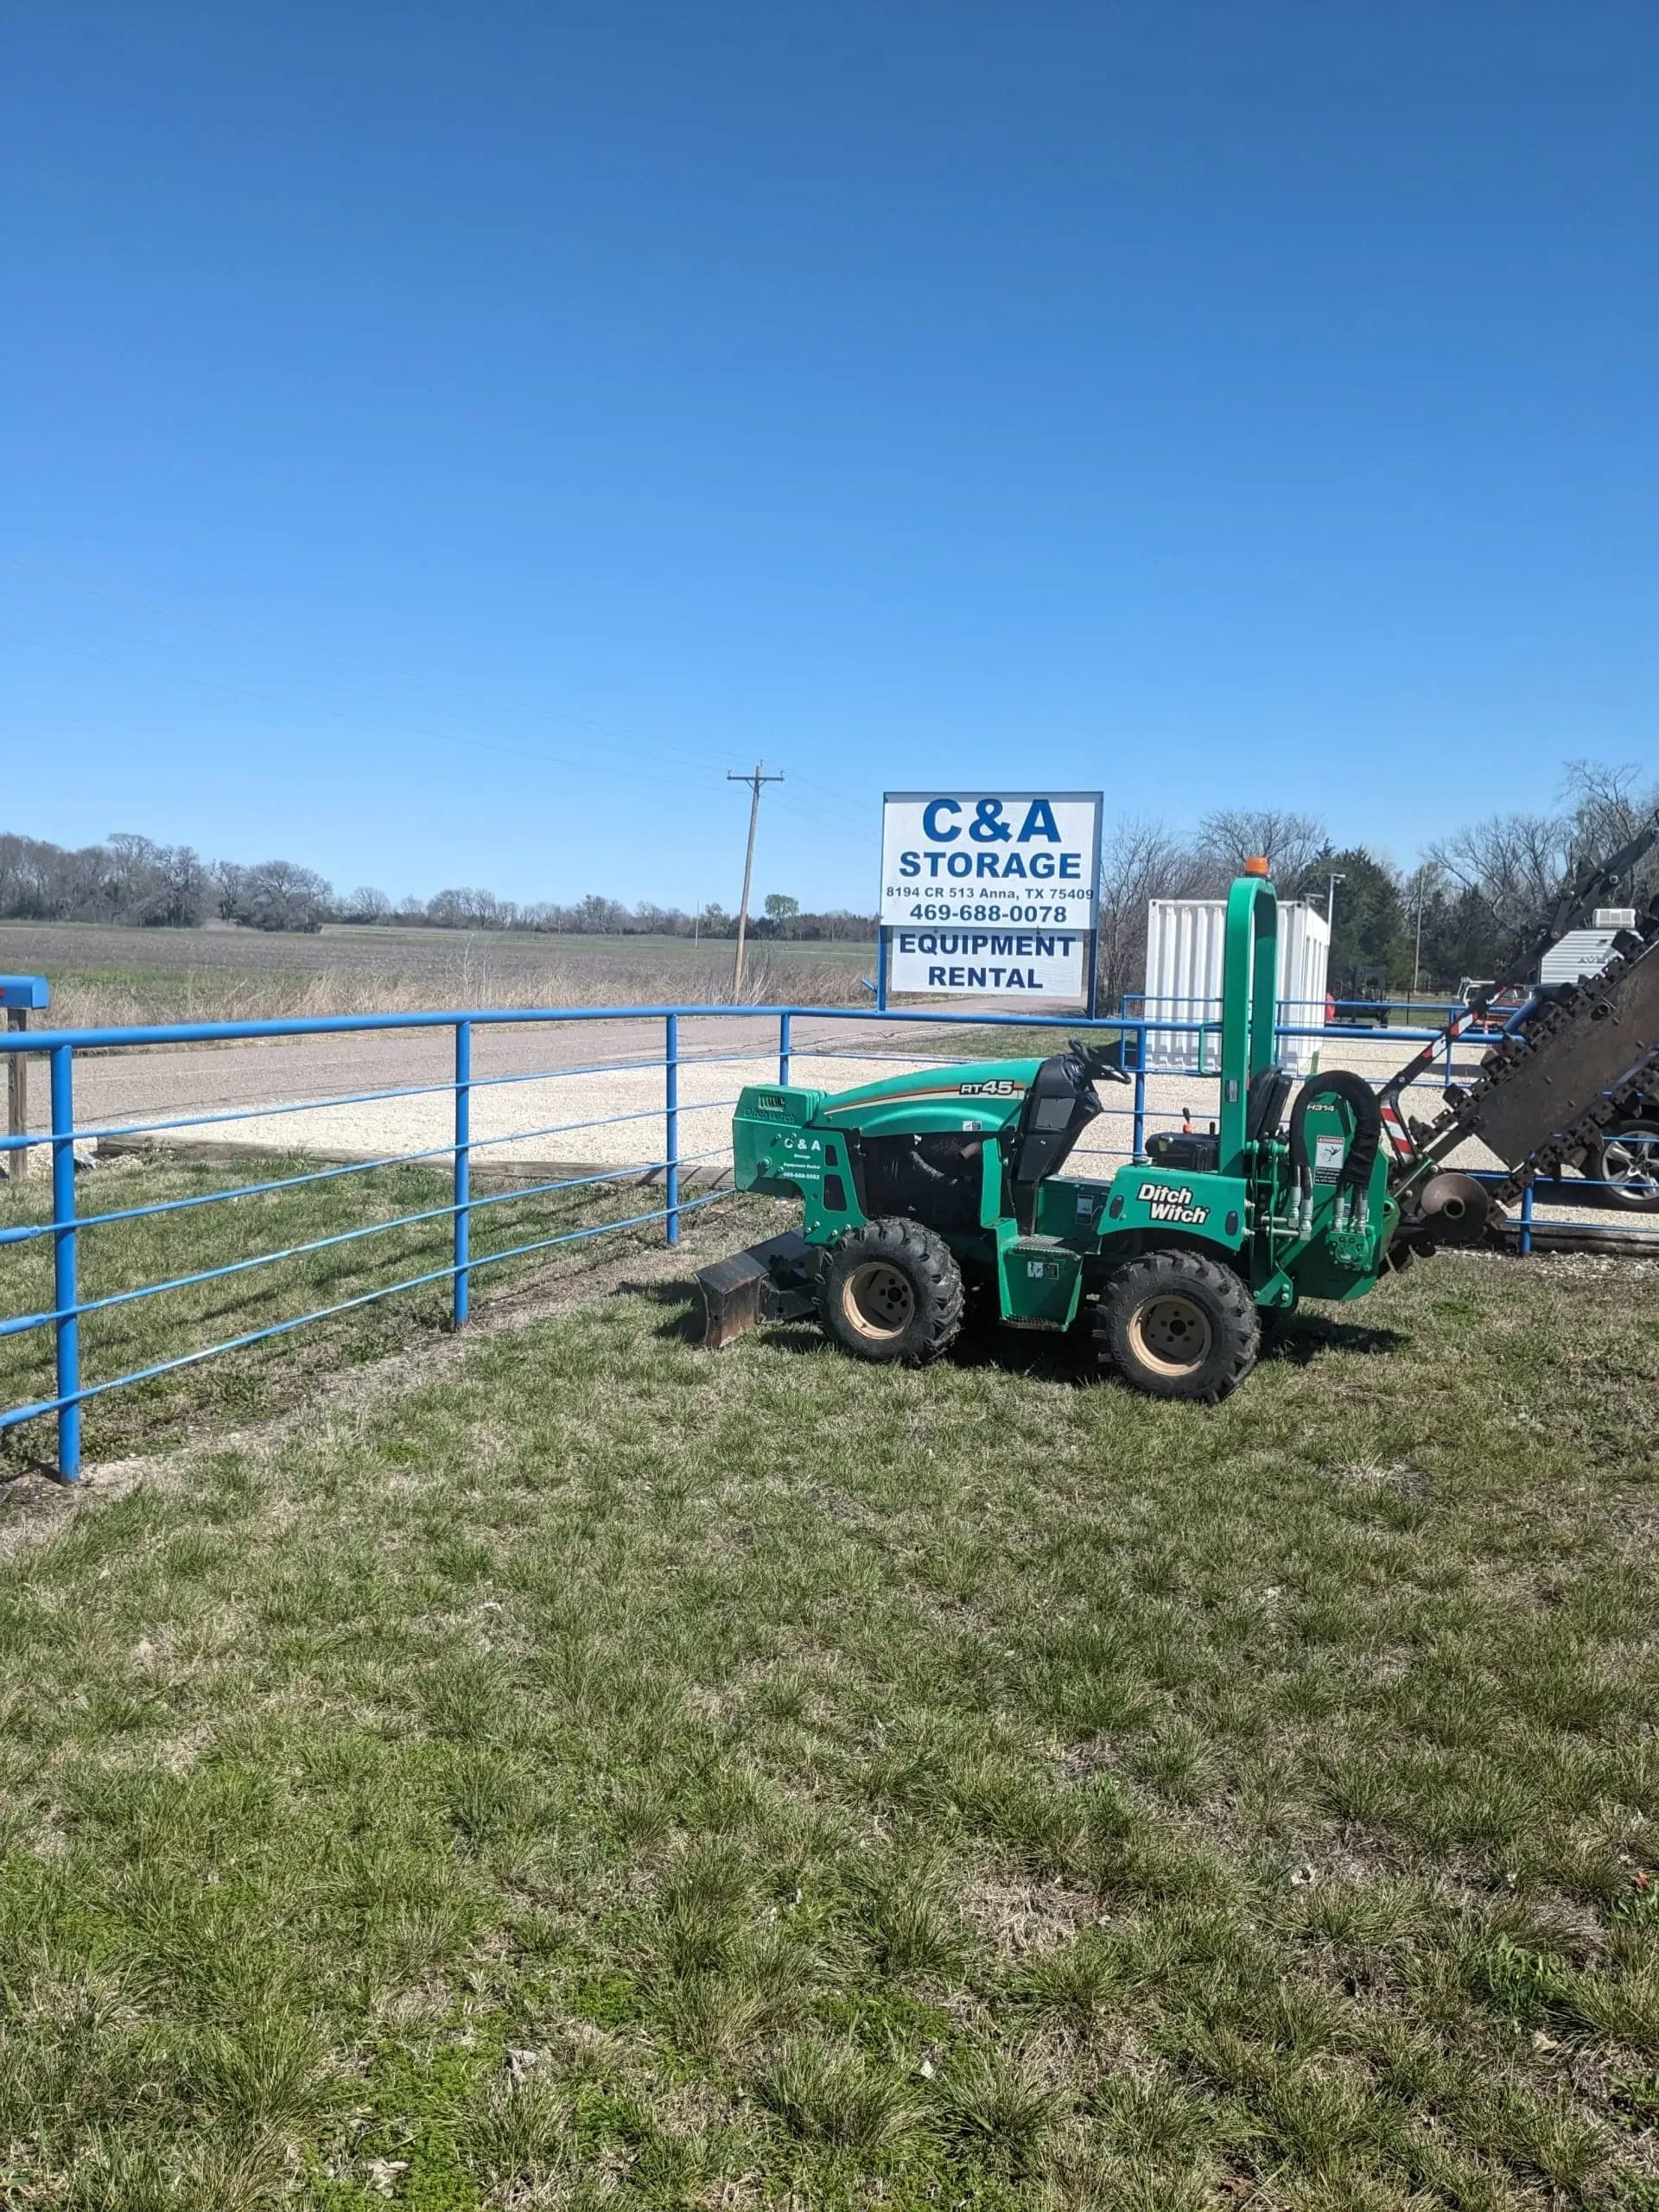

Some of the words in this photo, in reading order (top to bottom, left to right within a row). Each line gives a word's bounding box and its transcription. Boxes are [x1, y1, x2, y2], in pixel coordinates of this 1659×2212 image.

[923, 798, 1062, 842] C&A
[899, 851, 1081, 879] STORAGE
[887, 887, 920, 898] 8194
[925, 887, 944, 898] CR
[950, 888, 975, 899] 513
[979, 888, 1020, 901] Anna,
[1025, 888, 1044, 899] TX
[1050, 889, 1094, 900] 75409
[910, 904, 1067, 923] 469-688-0078
[899, 933, 1076, 957] EQUIPMENT
[928, 966, 1044, 988] RENTAL
[961, 1080, 1014, 1094] RT45
[1306, 1103, 1335, 1112] H314
[785, 1138, 794, 1148] C
[798, 1139, 807, 1149] &
[811, 1140, 821, 1151] A
[1138, 1184, 1192, 1204] Ditch
[1151, 1202, 1206, 1224] Witch
